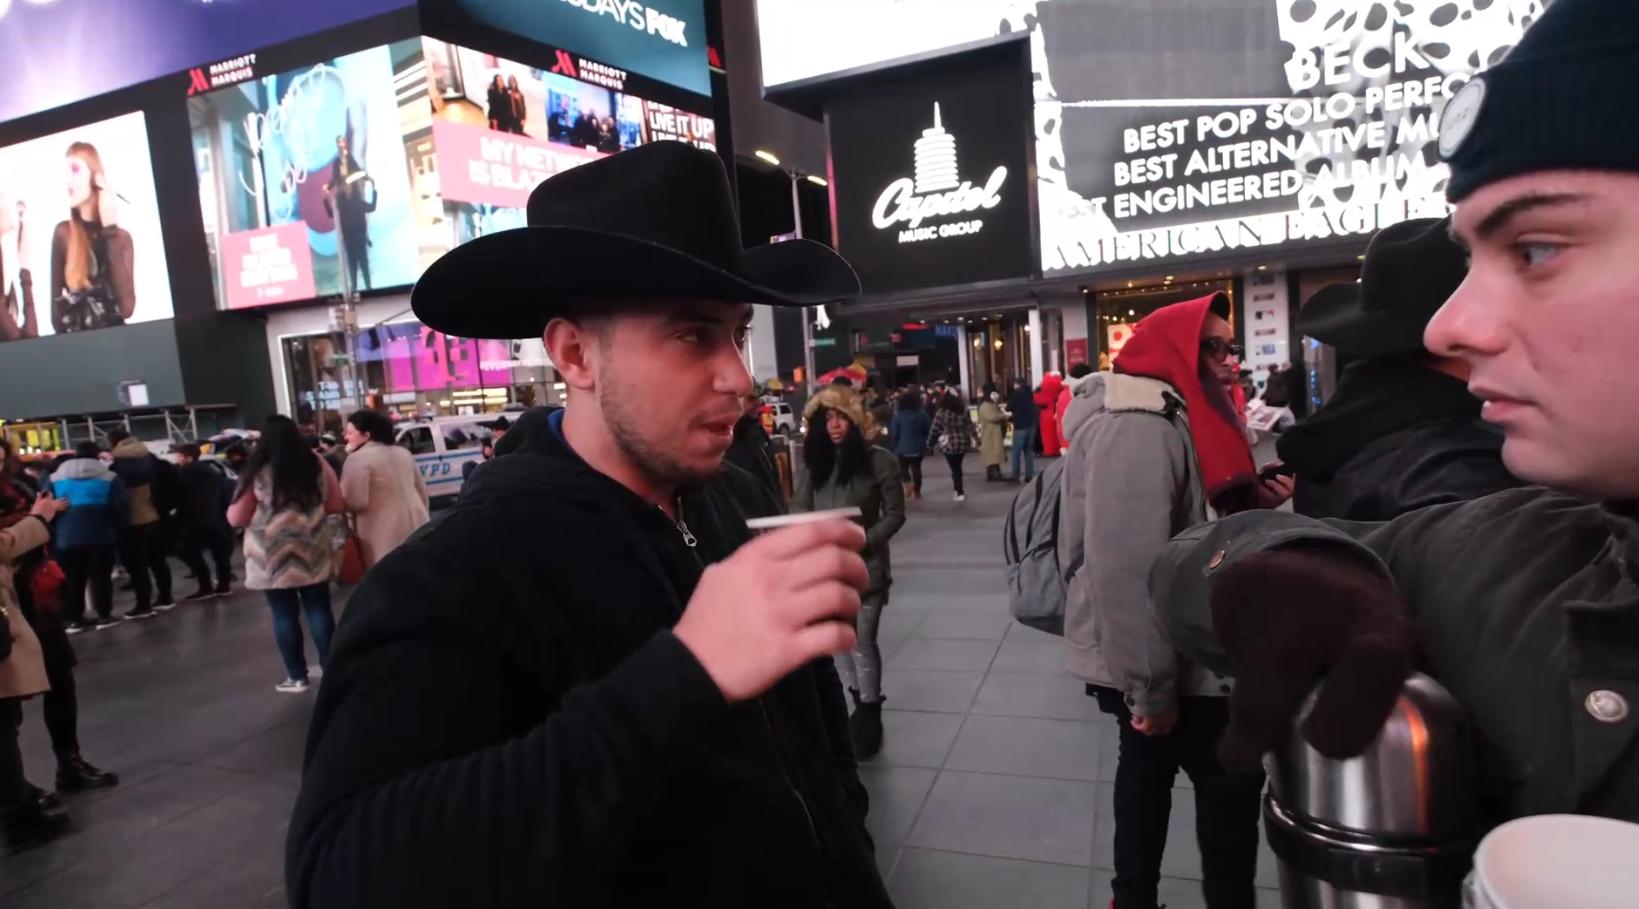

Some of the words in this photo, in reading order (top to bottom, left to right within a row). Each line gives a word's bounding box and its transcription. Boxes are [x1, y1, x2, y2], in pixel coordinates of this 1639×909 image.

[562, 0, 645, 31] DAYS
[645, 7, 688, 47] FOX
[209, 53, 256, 75] MARRIOTT
[578, 58, 627, 81] MARRIOTT
[1287, 31, 1430, 93] BECK
[579, 69, 624, 91] MARQUIS
[1123, 119, 1189, 154] BEST
[1197, 107, 1257, 144] POP
[1265, 92, 1356, 130] SOLO
[1365, 72, 1472, 115] PERFO
[690, 117, 715, 140] UP
[480, 136, 514, 164] MY
[1113, 153, 1178, 187] BEST
[1184, 120, 1386, 176] ALTERNATIVE
[872, 165, 1008, 229] Capitol
[1113, 168, 1304, 218] ENGINEERED
[1313, 149, 1426, 186] ALBUM
[898, 226, 938, 243] MUSIC
[939, 219, 983, 237] GROUP
[418, 462, 451, 477] YPD
